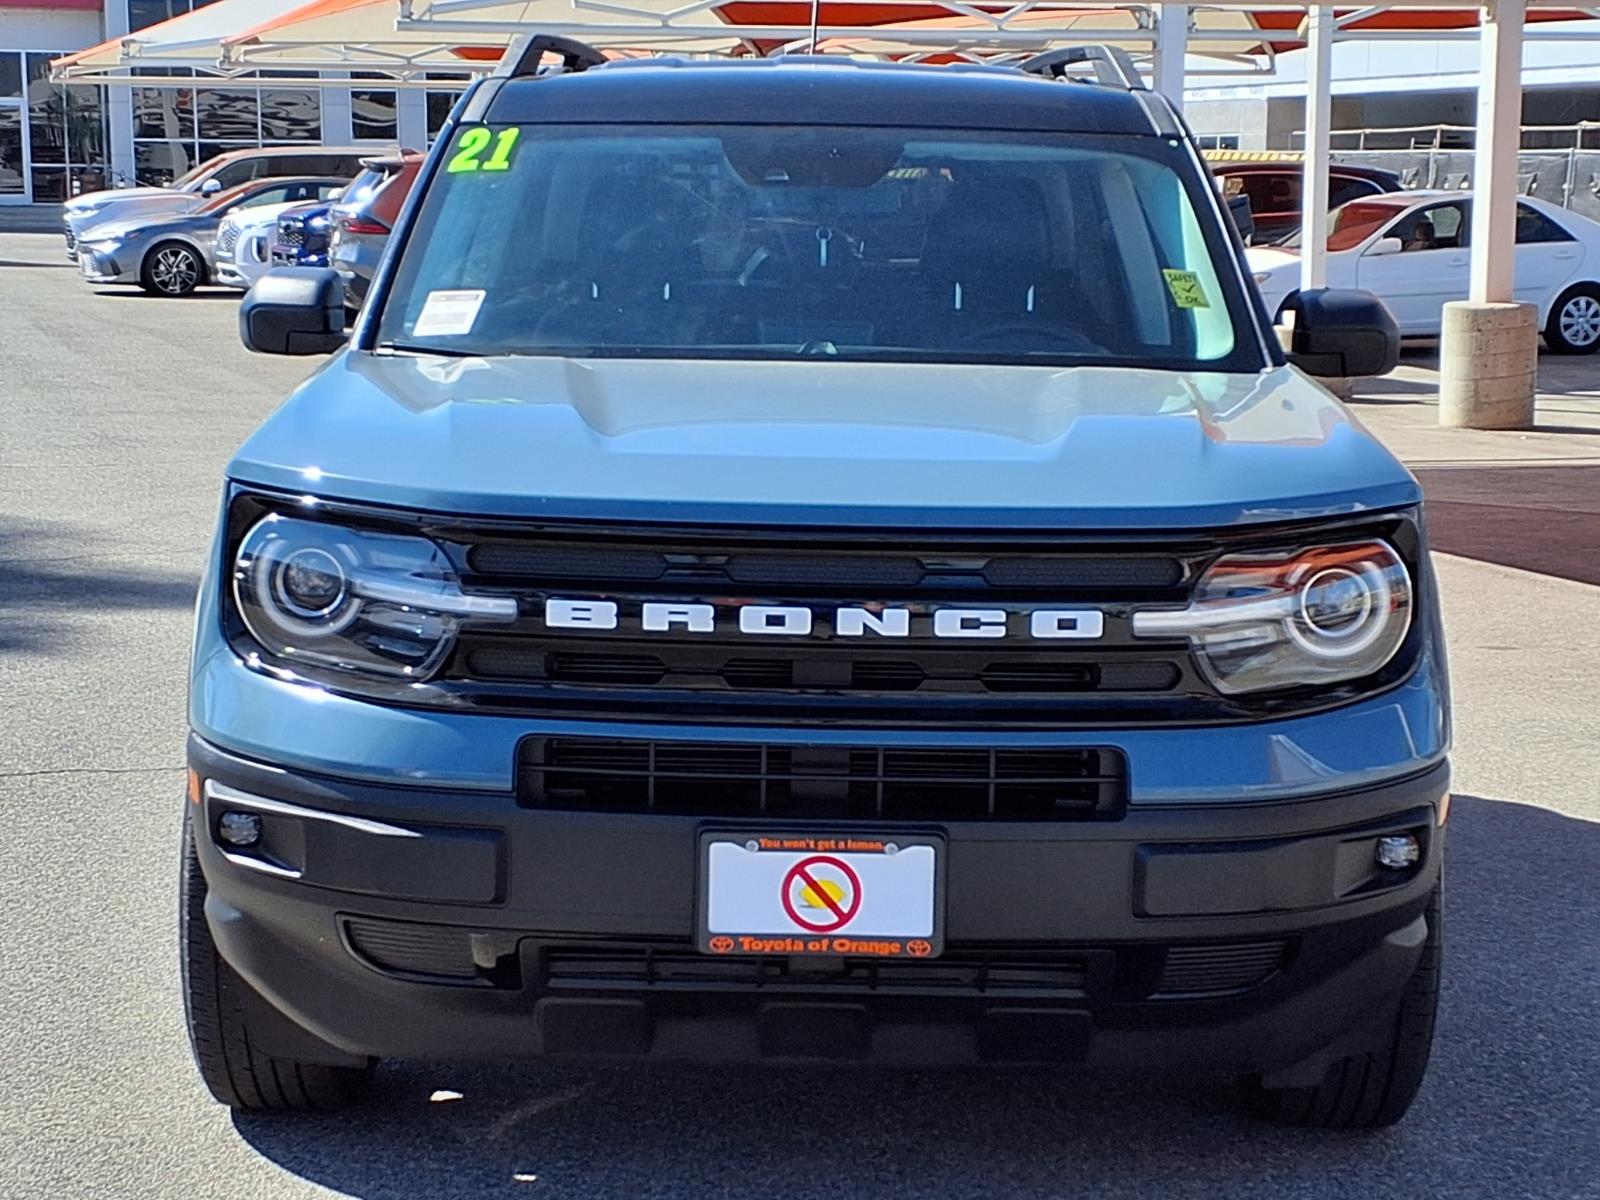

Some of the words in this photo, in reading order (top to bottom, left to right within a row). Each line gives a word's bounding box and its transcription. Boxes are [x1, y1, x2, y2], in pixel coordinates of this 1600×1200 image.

[447, 127, 519, 173] 21
[546, 599, 1103, 638] BRONCO
[759, 838, 780, 849] You
[783, 839, 815, 849] won't
[817, 839, 836, 851] get
[838, 841, 845, 849] a
[739, 936, 804, 952] Toyota
[807, 938, 830, 951] of
[832, 939, 901, 955] Orange
